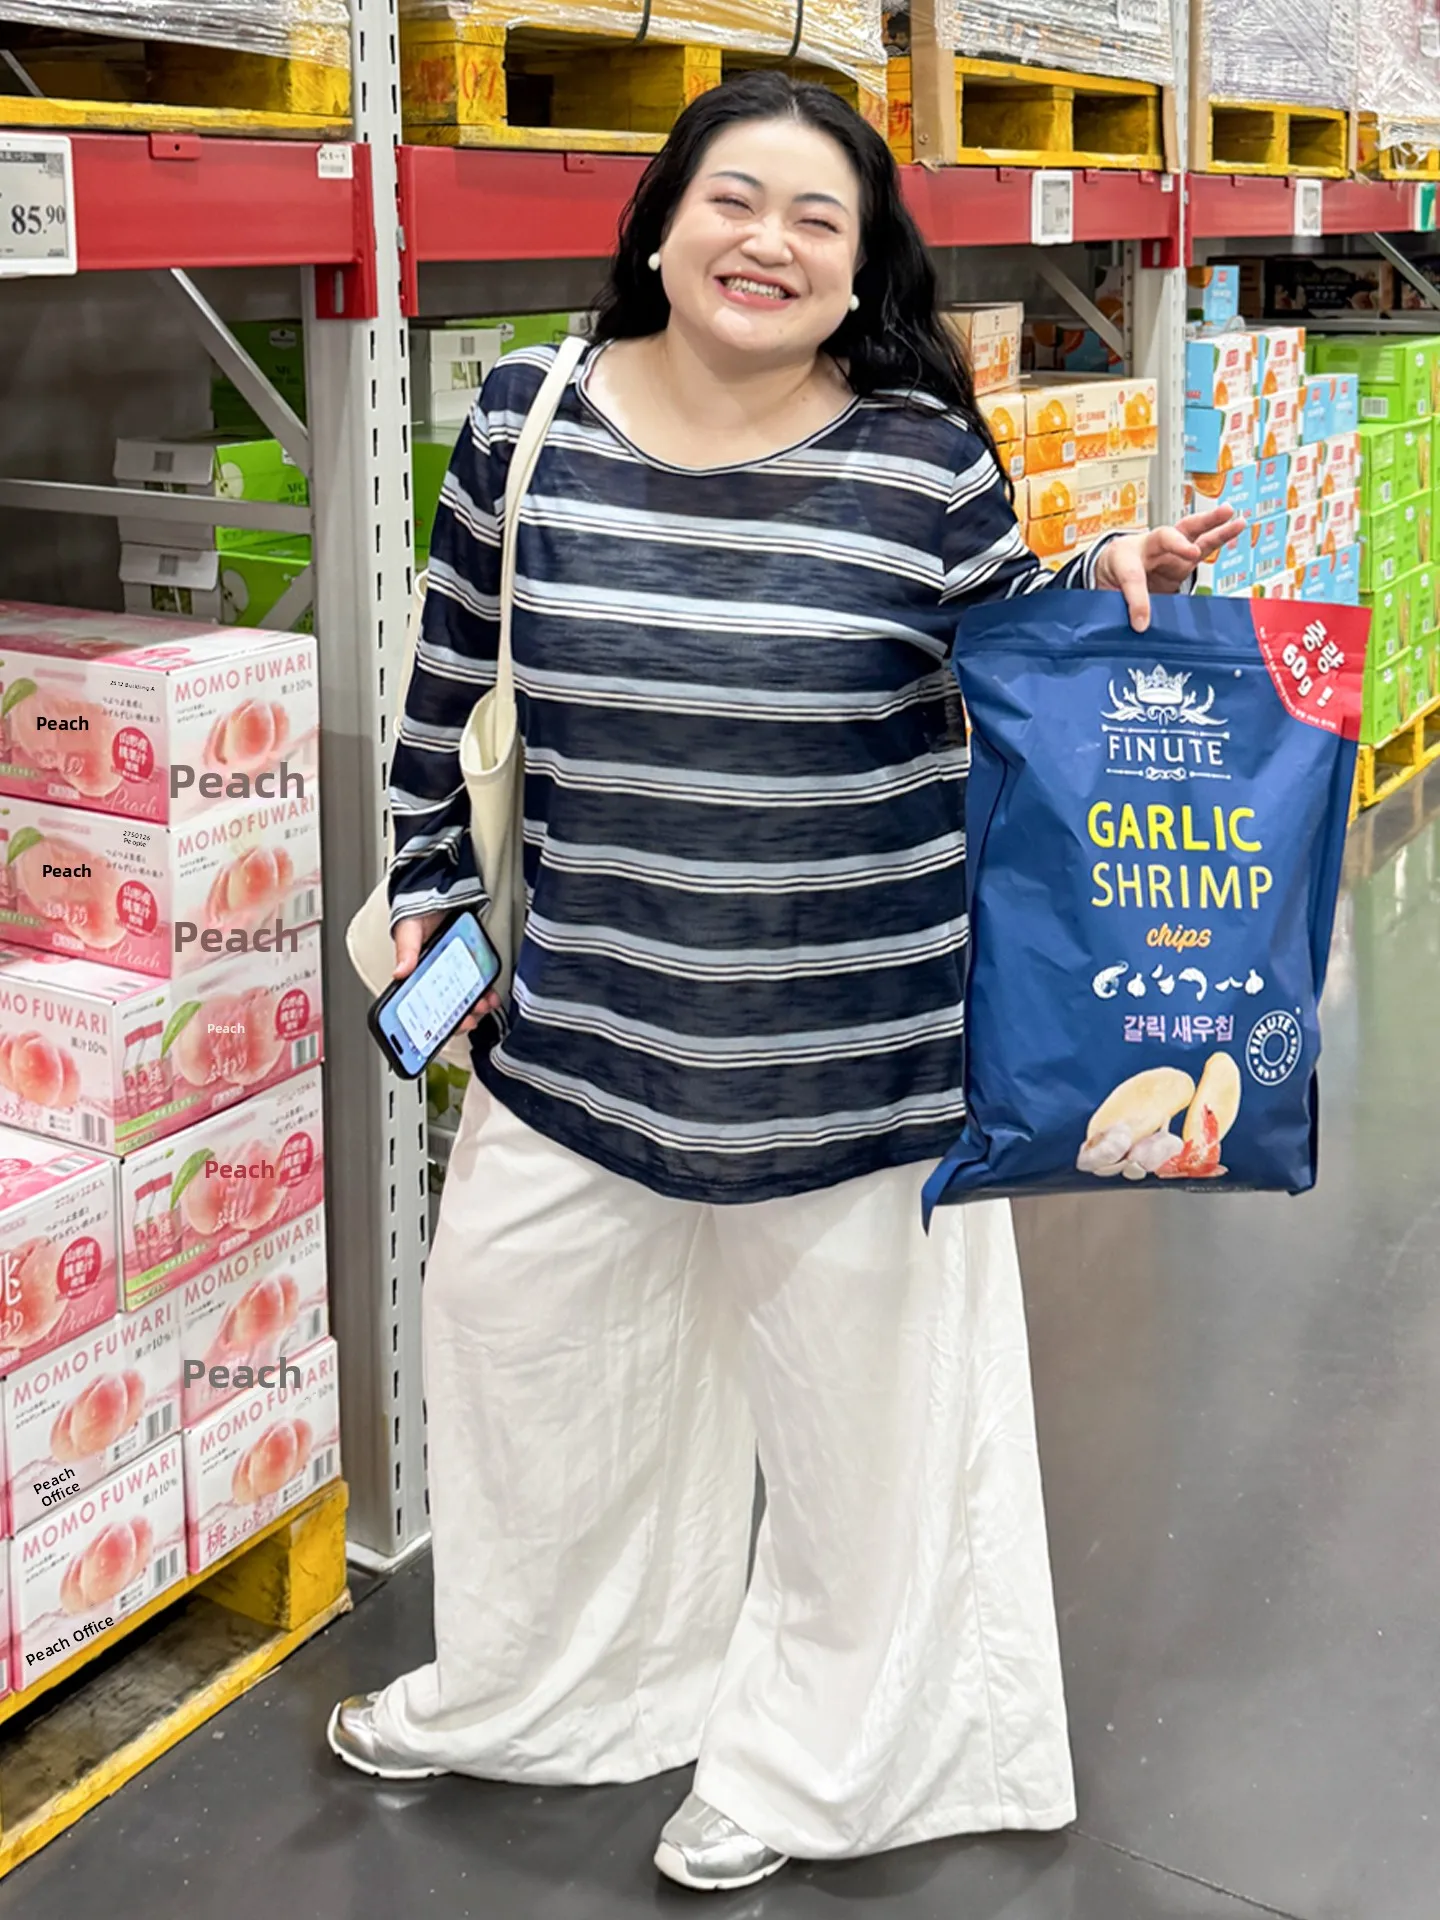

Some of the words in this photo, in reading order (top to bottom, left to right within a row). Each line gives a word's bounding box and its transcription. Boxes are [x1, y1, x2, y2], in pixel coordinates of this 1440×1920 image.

[175, 670, 240, 703] MOMO
[245, 652, 312, 686] FUWARI
[1108, 735, 1224, 766] FINUTE
[177, 819, 243, 858] MOMO
[247, 794, 315, 833] FUWARI
[1087, 801, 1263, 852] GARLIC
[1091, 861, 1273, 910] SHRIMP
[1146, 922, 1212, 953] chips
[32, 999, 107, 1035] FUWARI
[1124, 1015, 1166, 1042] 갈릭
[1249, 1015, 1292, 1055] FINUTE
[185, 1256, 249, 1307] MOMO
[253, 1213, 320, 1268] FUWARI
[13, 1351, 89, 1409] MOMO
[94, 1303, 171, 1363] FUWARI
[200, 1401, 263, 1456] MOMO
[22, 1501, 96, 1563] MOMO
[101, 1448, 177, 1513] FUWARI
